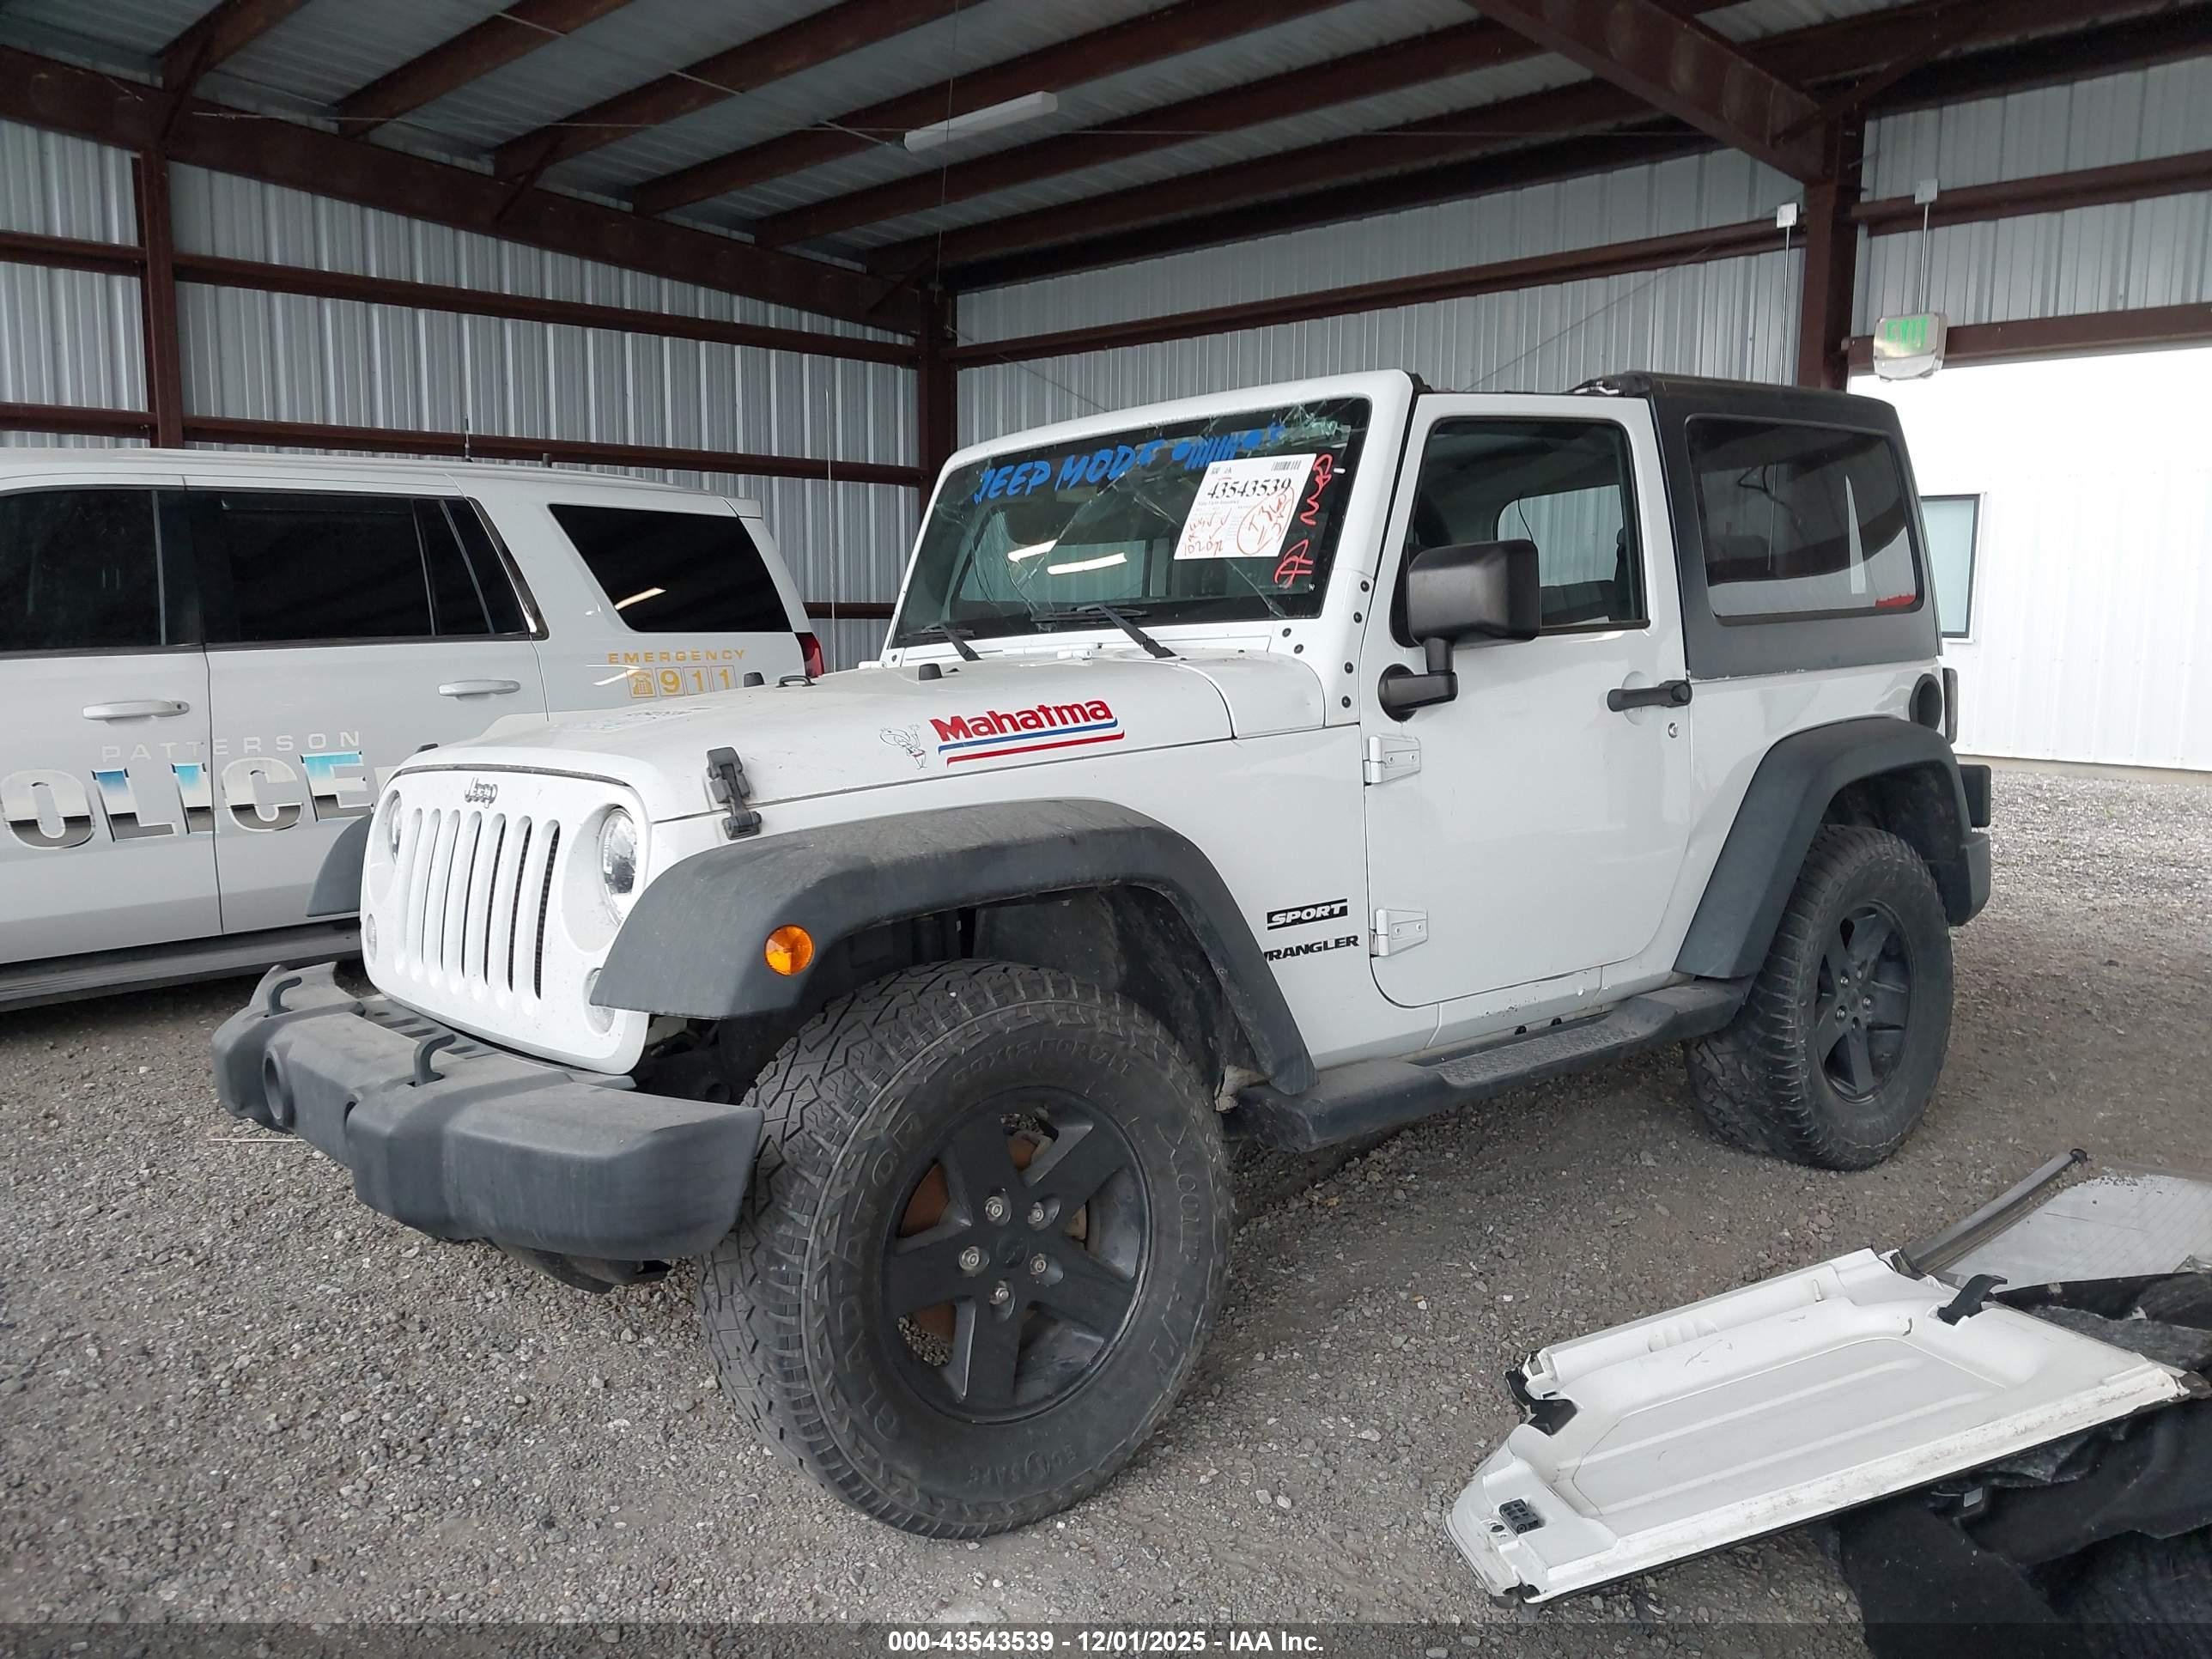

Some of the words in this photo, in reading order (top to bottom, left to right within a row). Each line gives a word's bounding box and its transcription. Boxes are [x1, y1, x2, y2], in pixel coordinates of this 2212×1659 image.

[973, 459, 1052, 504] JEEP
[1207, 477, 1291, 500] 43543539
[608, 650, 745, 664] EMERGENCY
[659, 668, 730, 694] 911
[929, 699, 1115, 743] Mahatma
[101, 730, 361, 763] PATTERSON
[465, 777, 498, 809] Jeep
[1270, 904, 1345, 927] SPORT
